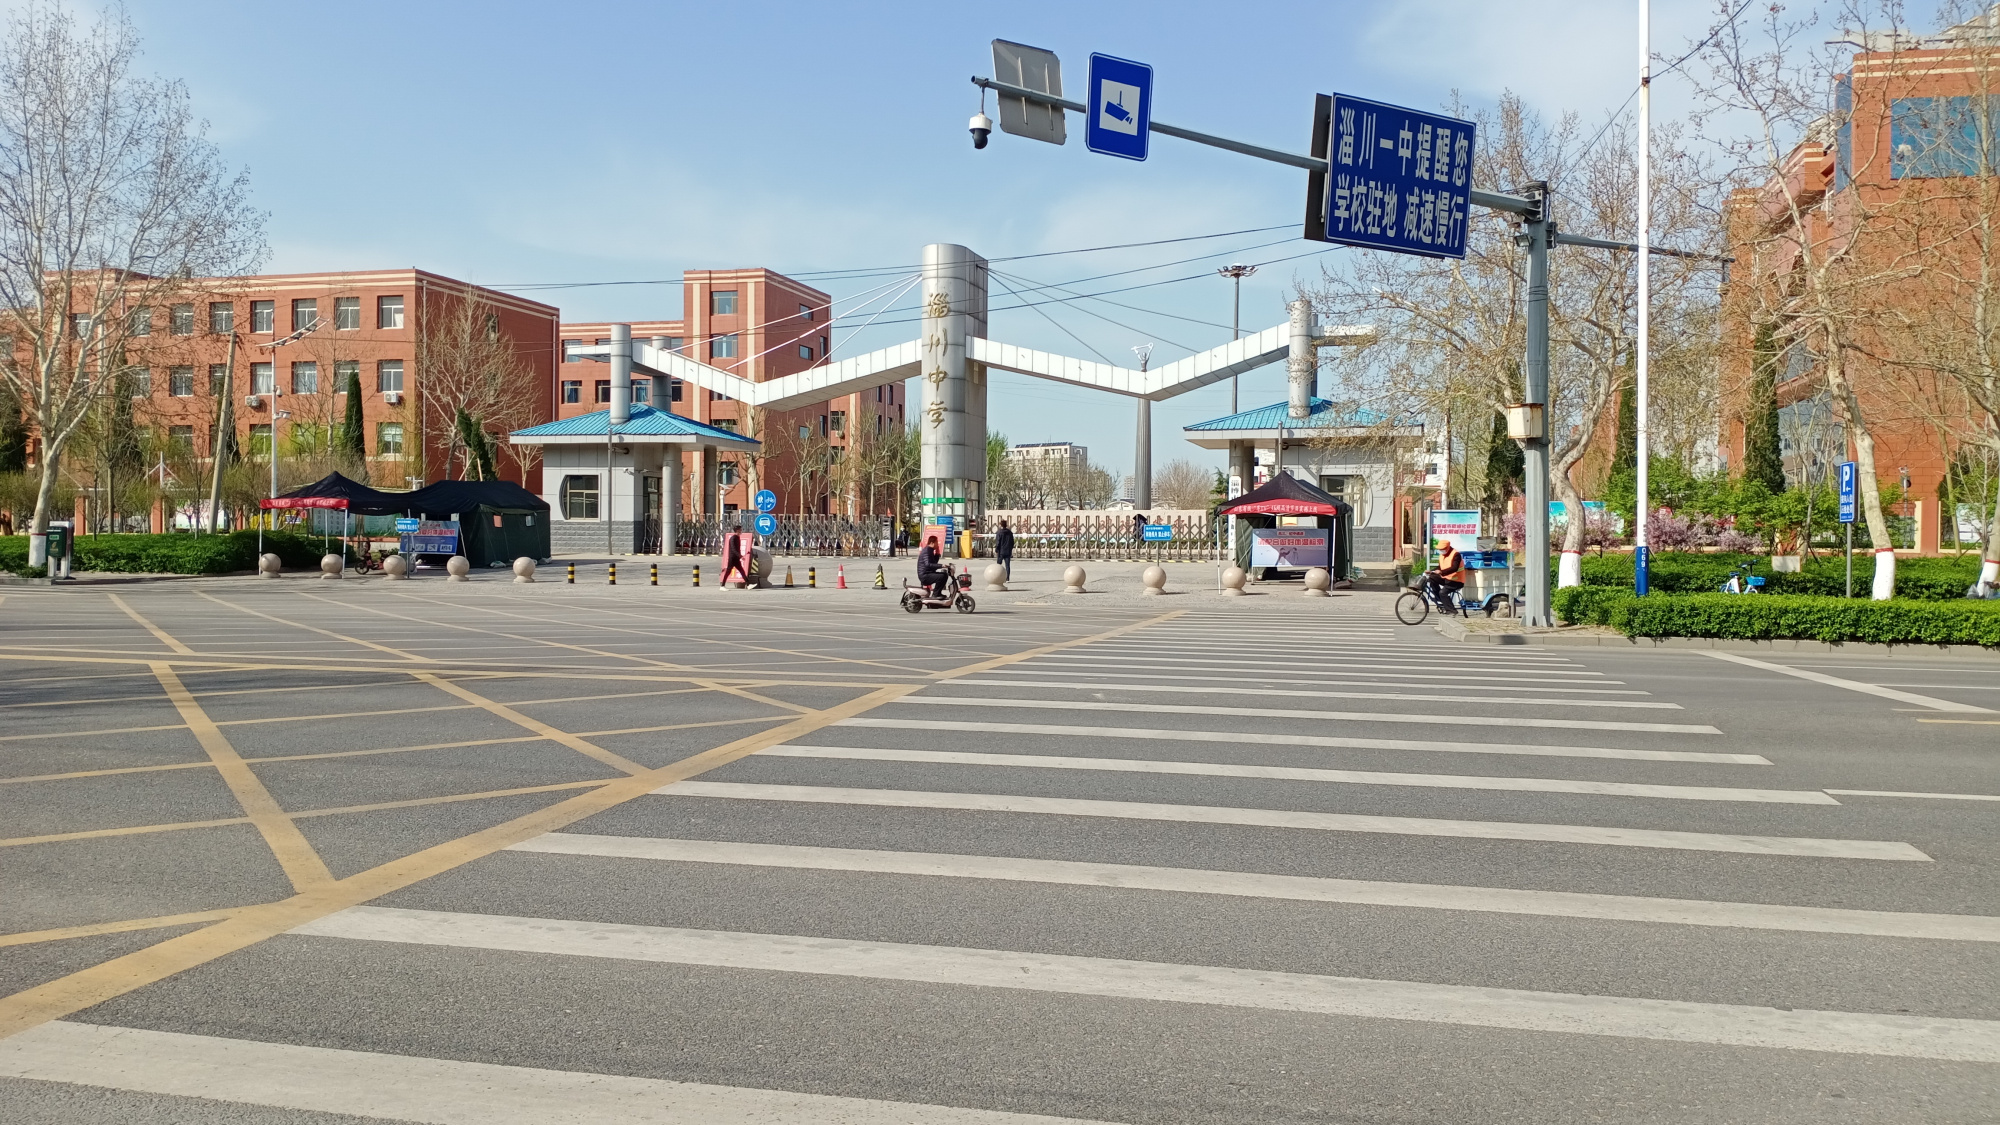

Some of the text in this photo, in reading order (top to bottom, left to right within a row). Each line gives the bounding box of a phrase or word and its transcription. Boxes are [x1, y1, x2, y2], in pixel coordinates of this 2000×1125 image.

[1337, 105, 1469, 187] 淄川一中提醒您
[1334, 172, 1464, 248] 学校驻地 减速慢行
[927, 292, 950, 429] 淄川中学
[1842, 465, 1851, 492] P
